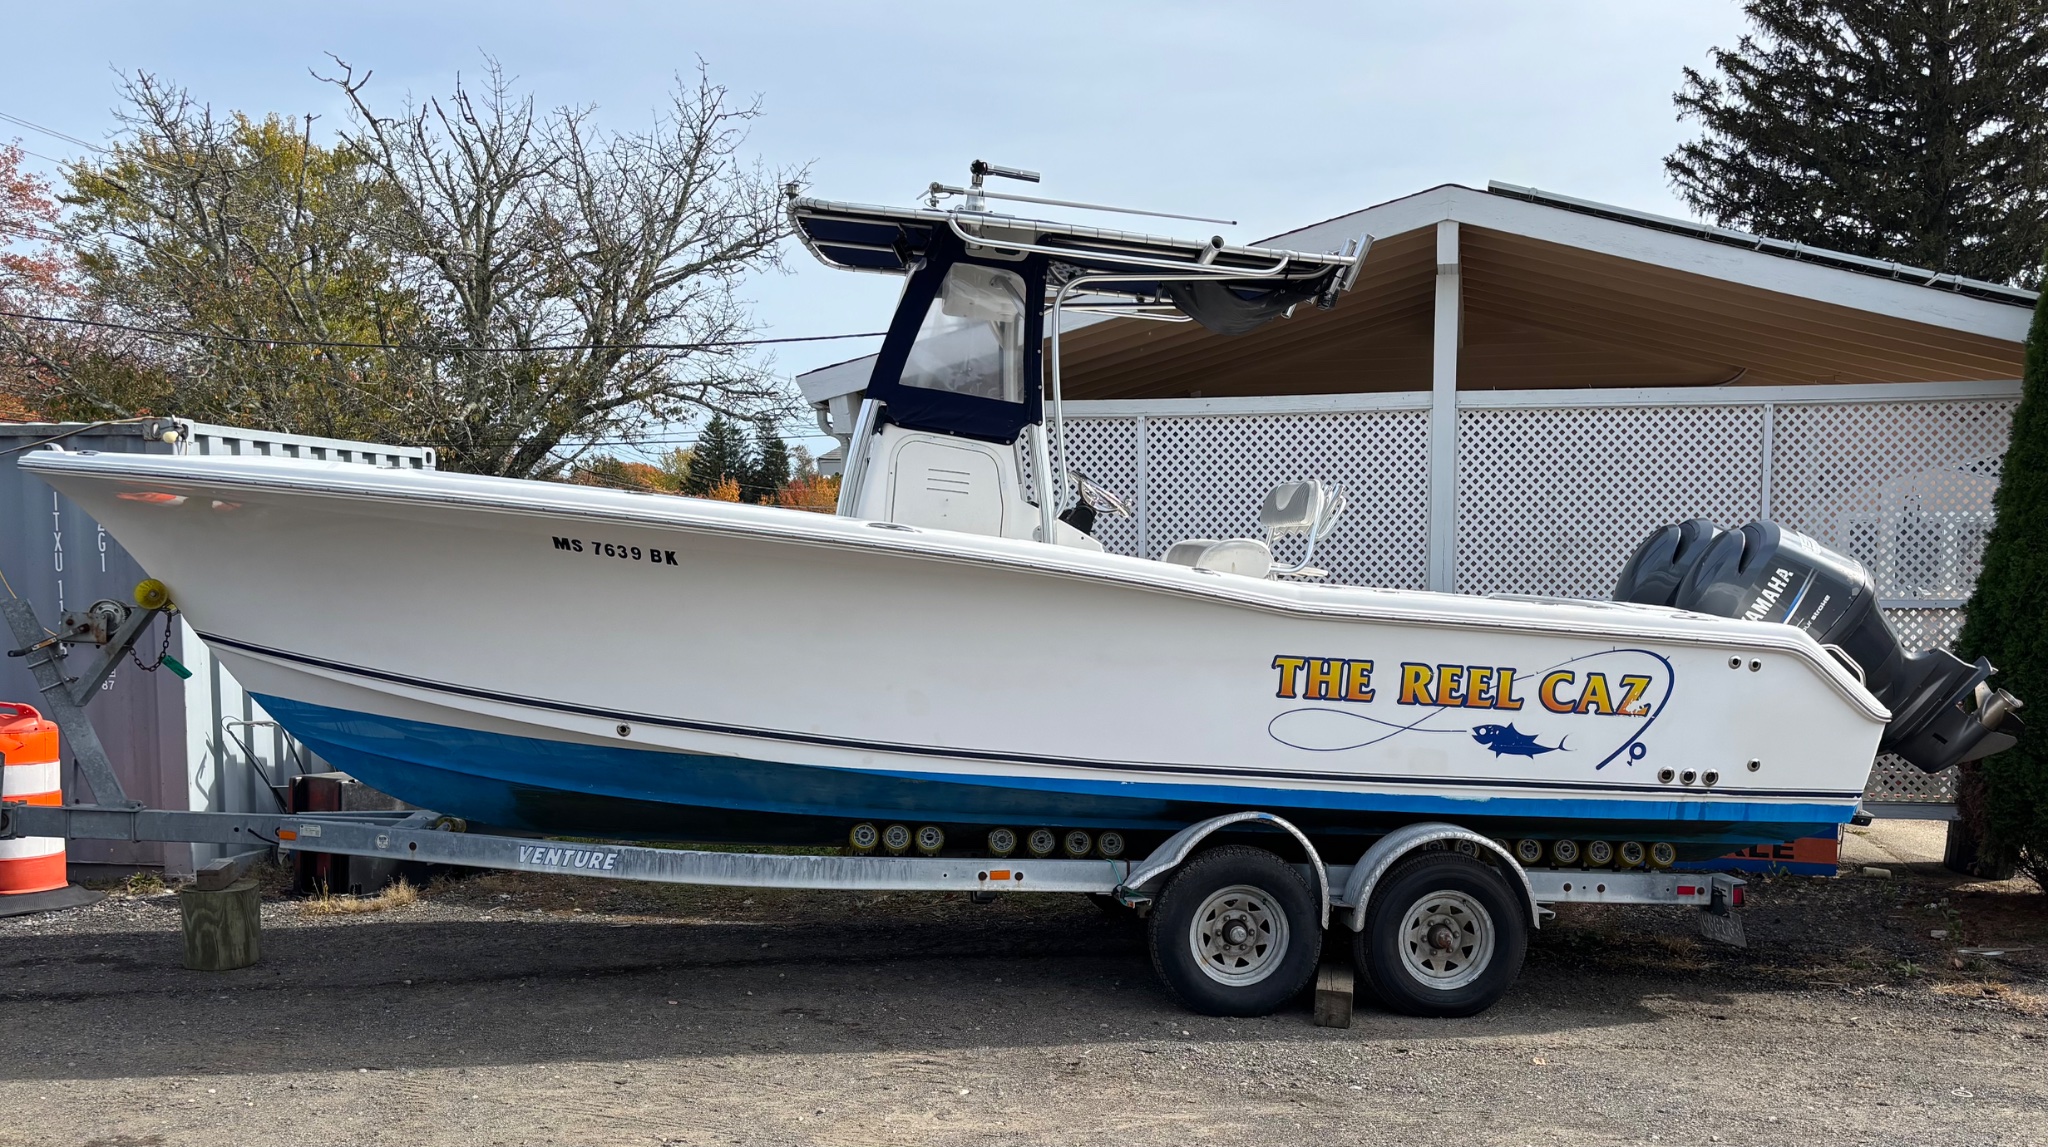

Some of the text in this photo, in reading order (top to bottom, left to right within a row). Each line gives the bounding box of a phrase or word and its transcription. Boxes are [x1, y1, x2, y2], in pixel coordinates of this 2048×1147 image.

[552, 536, 679, 566] MS 7639 BK
[1741, 567, 1794, 621] AMAHA
[1811, 594, 1831, 620] stroke
[1271, 655, 1652, 717] THE REEL CAZ
[519, 844, 618, 871] VENTURE
